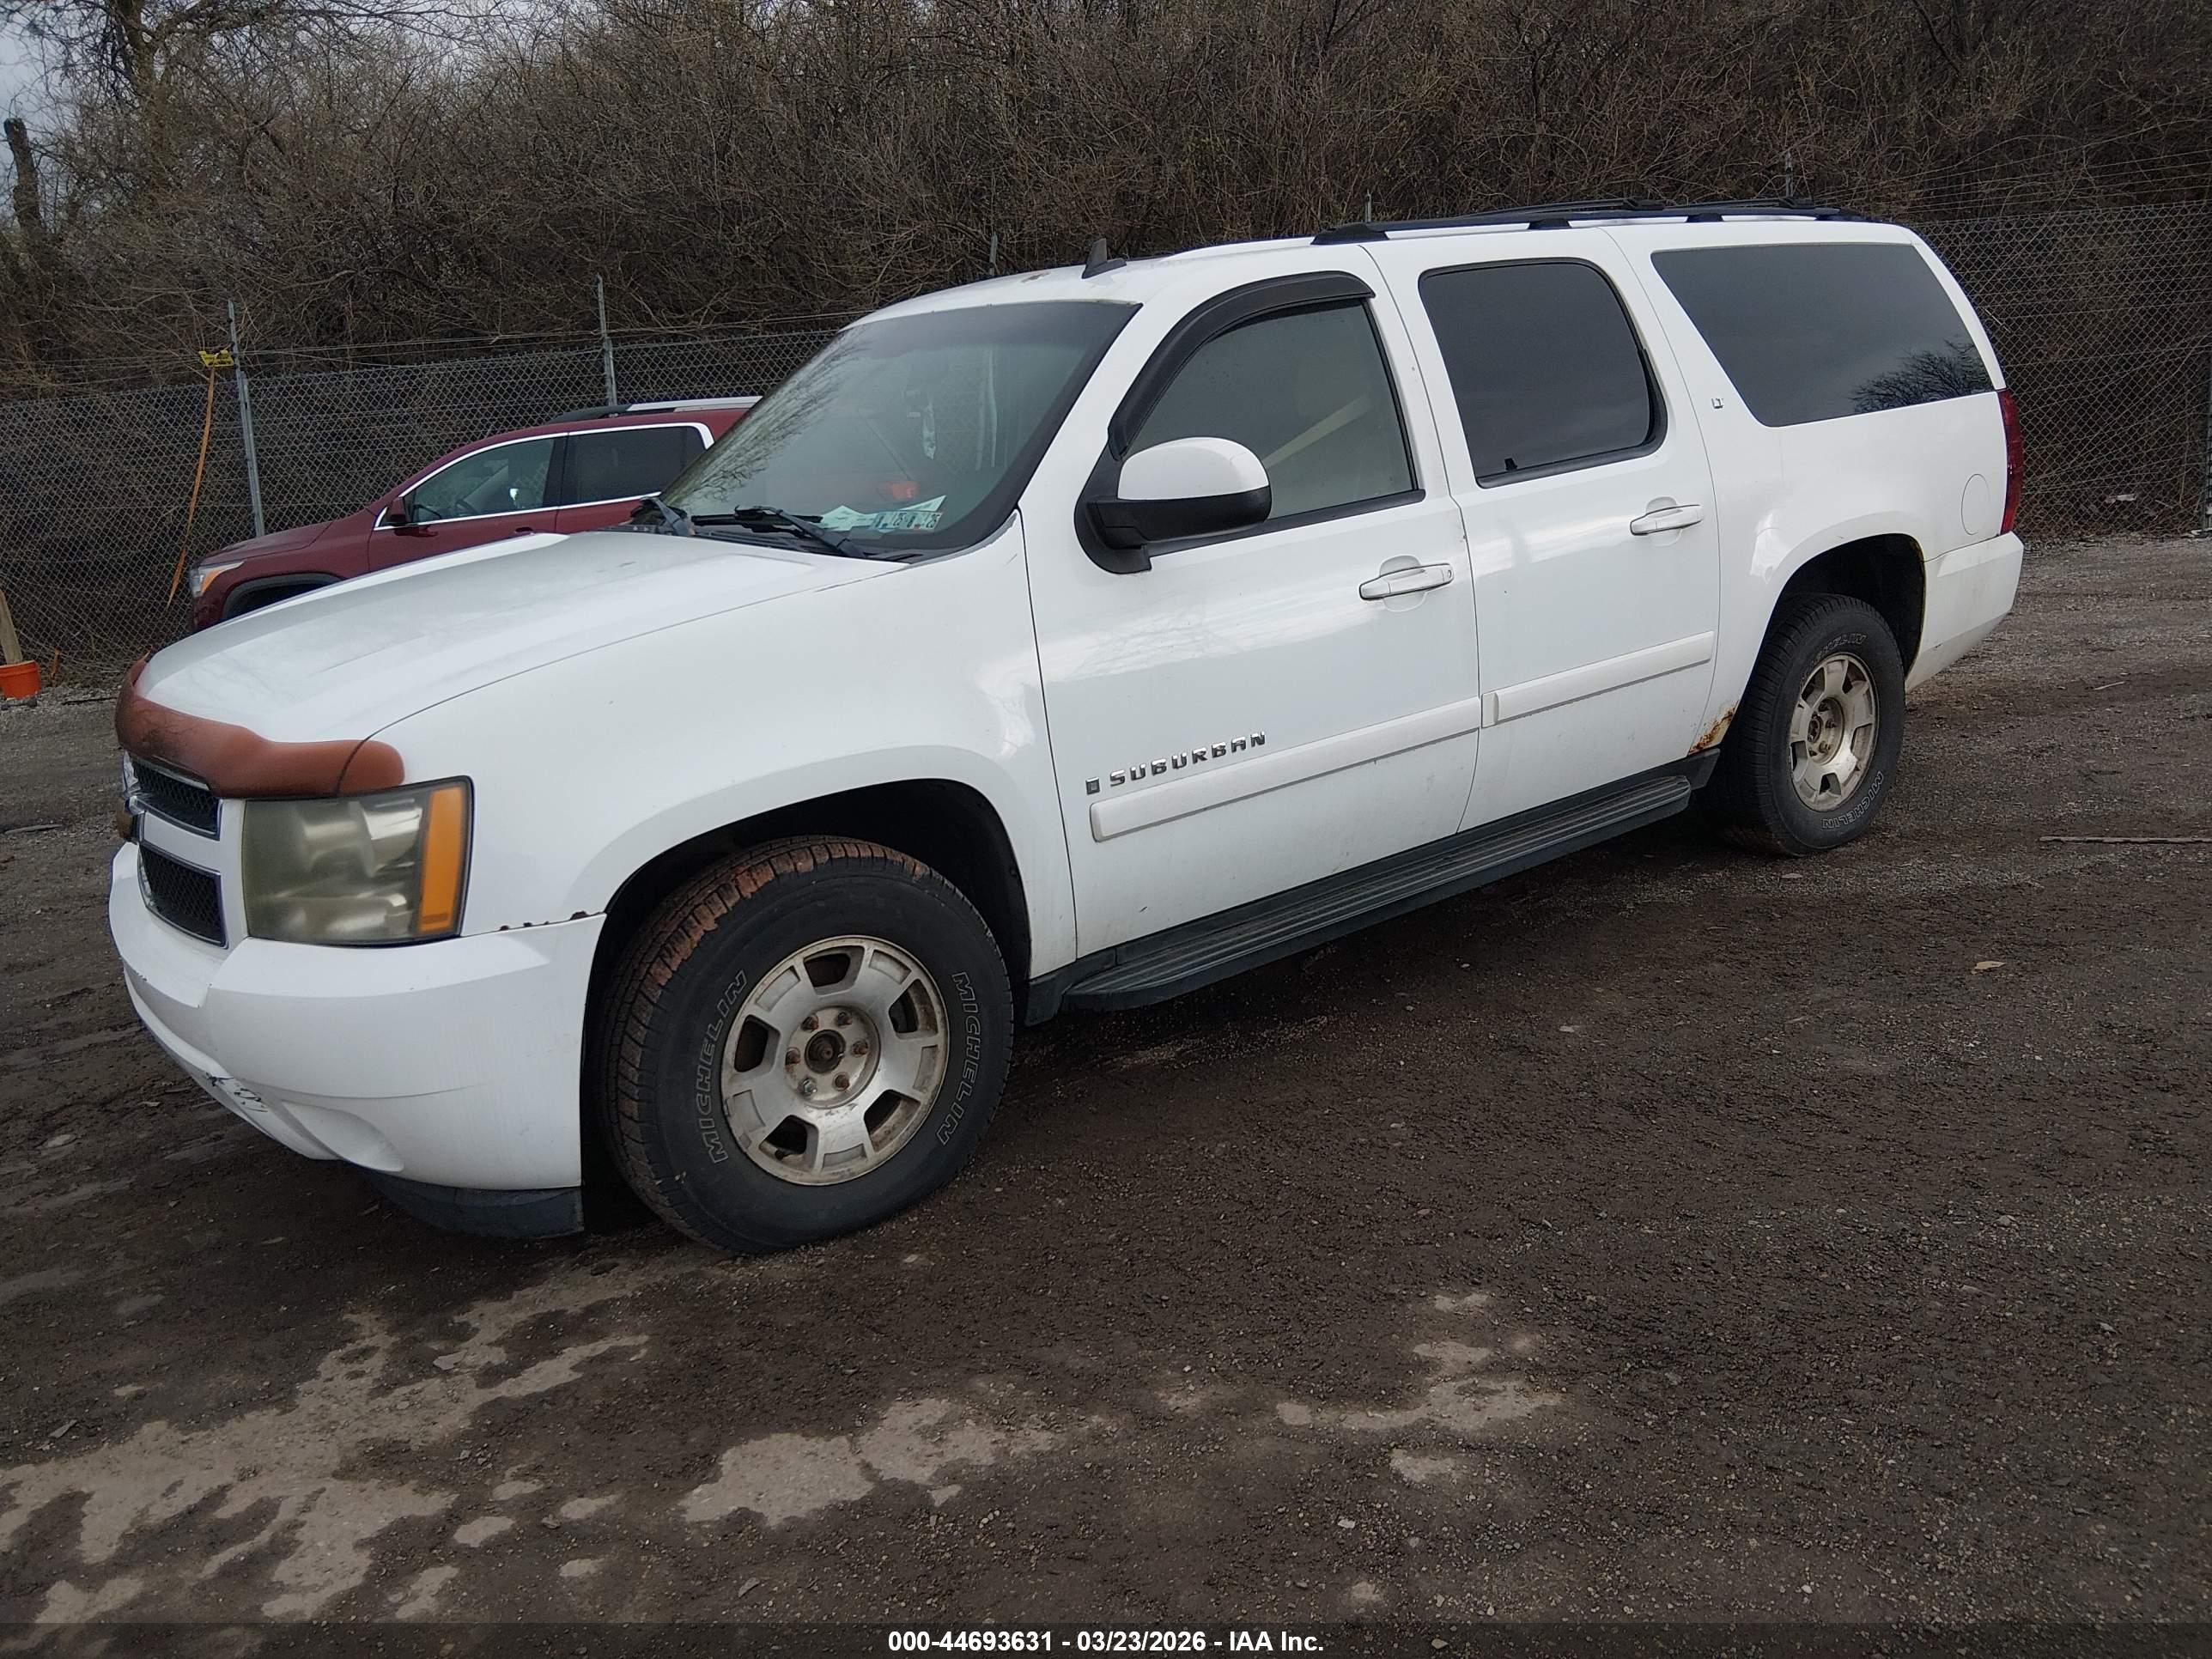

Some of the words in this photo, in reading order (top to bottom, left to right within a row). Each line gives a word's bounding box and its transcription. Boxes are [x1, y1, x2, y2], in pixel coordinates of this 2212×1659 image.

[1109, 731, 1267, 787] SUBURBAN
[1821, 770, 1885, 830] MICHELIN
[696, 969, 748, 1164] MICHELIN
[936, 971, 981, 1146] MICHELIN
